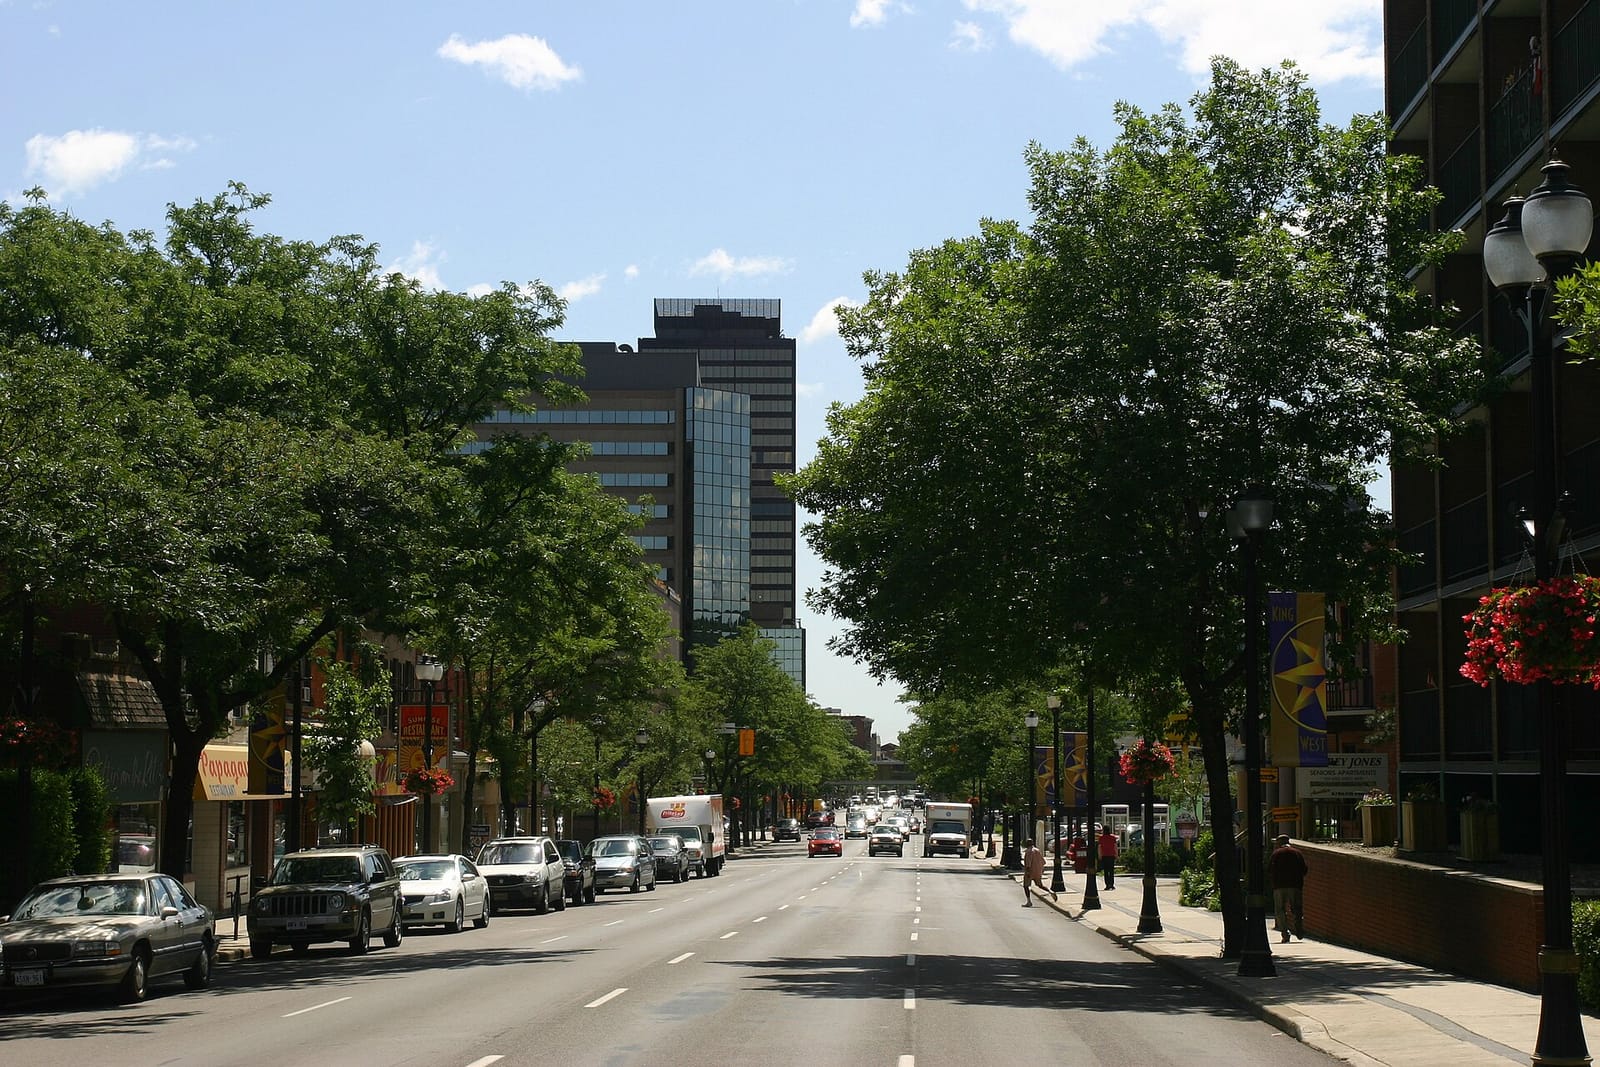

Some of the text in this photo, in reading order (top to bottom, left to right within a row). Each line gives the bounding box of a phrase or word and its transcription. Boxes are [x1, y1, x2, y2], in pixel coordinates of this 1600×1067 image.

[1271, 606, 1295, 622] KING
[407, 715, 441, 724] SUNSE
[403, 724, 444, 736] RESTAANT
[1299, 735, 1327, 752] WEST
[1347, 757, 1383, 769] JONES
